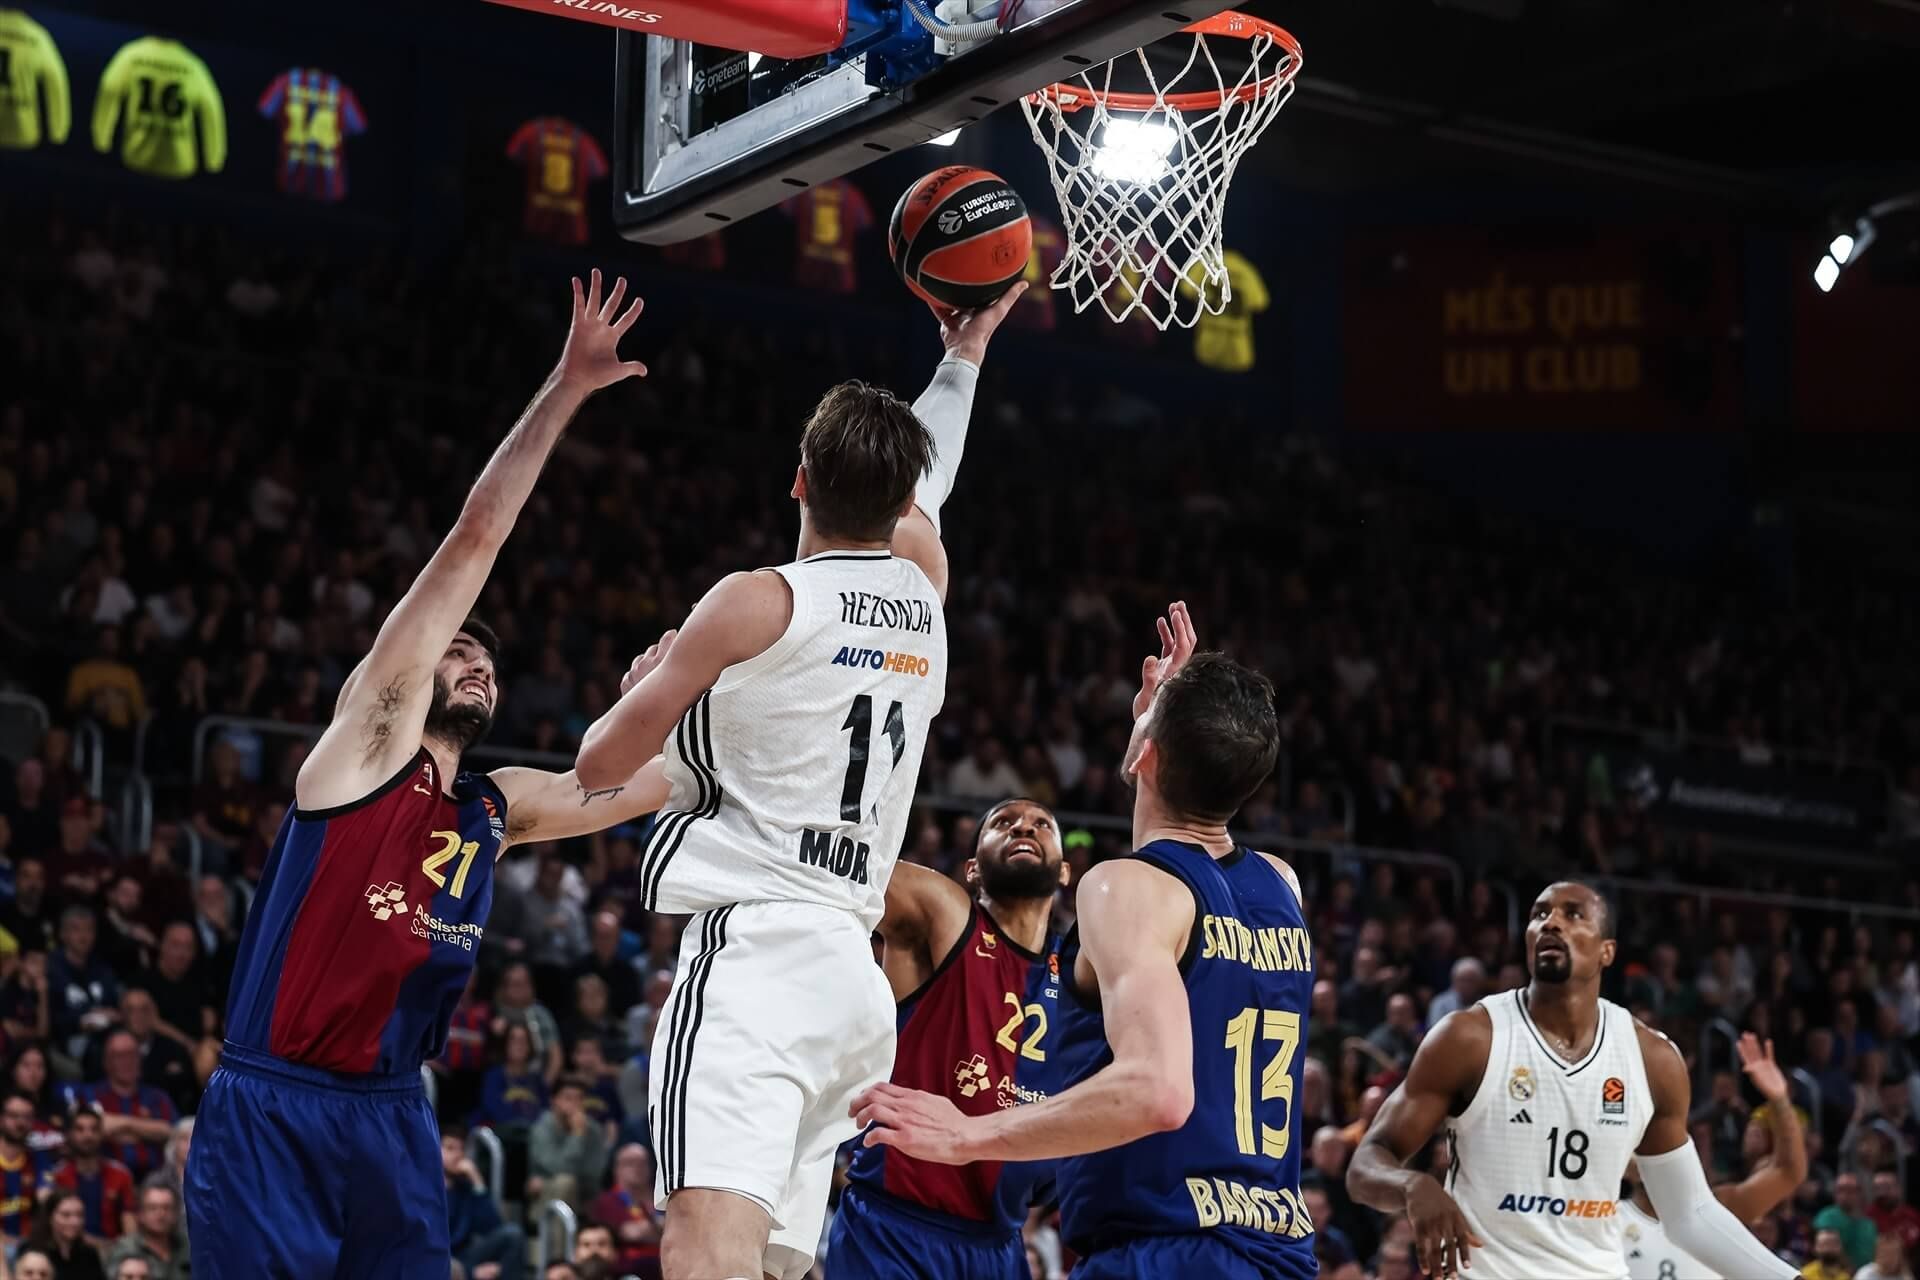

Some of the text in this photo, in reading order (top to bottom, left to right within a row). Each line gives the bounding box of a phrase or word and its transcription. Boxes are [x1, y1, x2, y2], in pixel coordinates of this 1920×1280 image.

[140, 77, 185, 118] 16
[960, 191, 997, 212] TURKISH
[1443, 271, 1643, 338] MÉS QUE
[1443, 343, 1642, 394] UN CLUB
[838, 592, 932, 634] HEZONJA
[831, 646, 929, 677] AUTOHERO
[841, 694, 906, 825] 11
[422, 830, 481, 900] 21
[996, 992, 1048, 1062] 22
[1225, 1007, 1300, 1161] 13
[1546, 1127, 1590, 1181] 18
